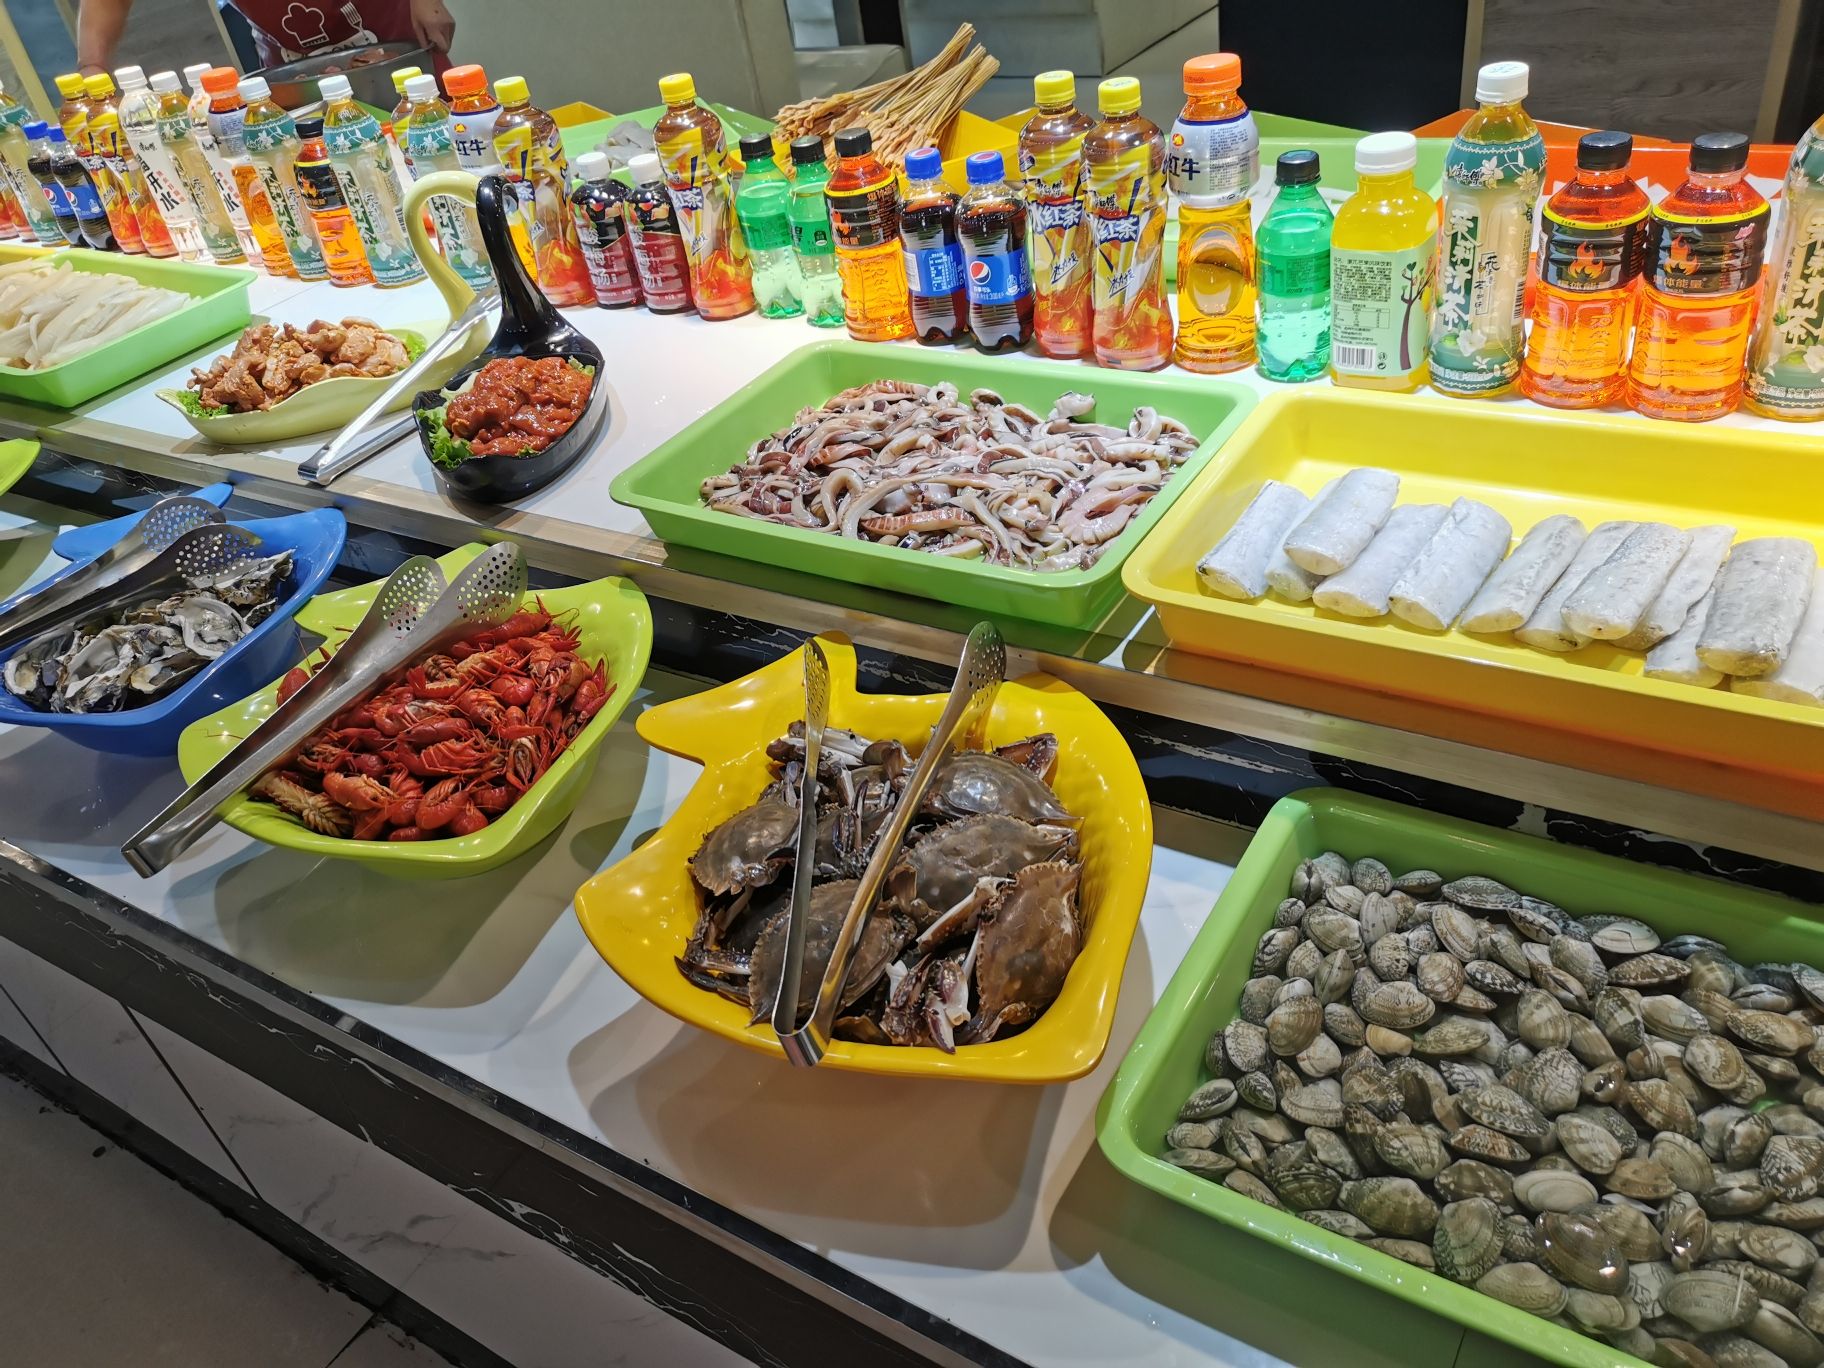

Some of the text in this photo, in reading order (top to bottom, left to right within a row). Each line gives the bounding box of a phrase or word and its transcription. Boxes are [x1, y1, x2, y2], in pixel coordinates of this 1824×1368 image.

[1162, 153, 1201, 181] 红牛
[1439, 208, 1483, 331] 茉莉清茶
